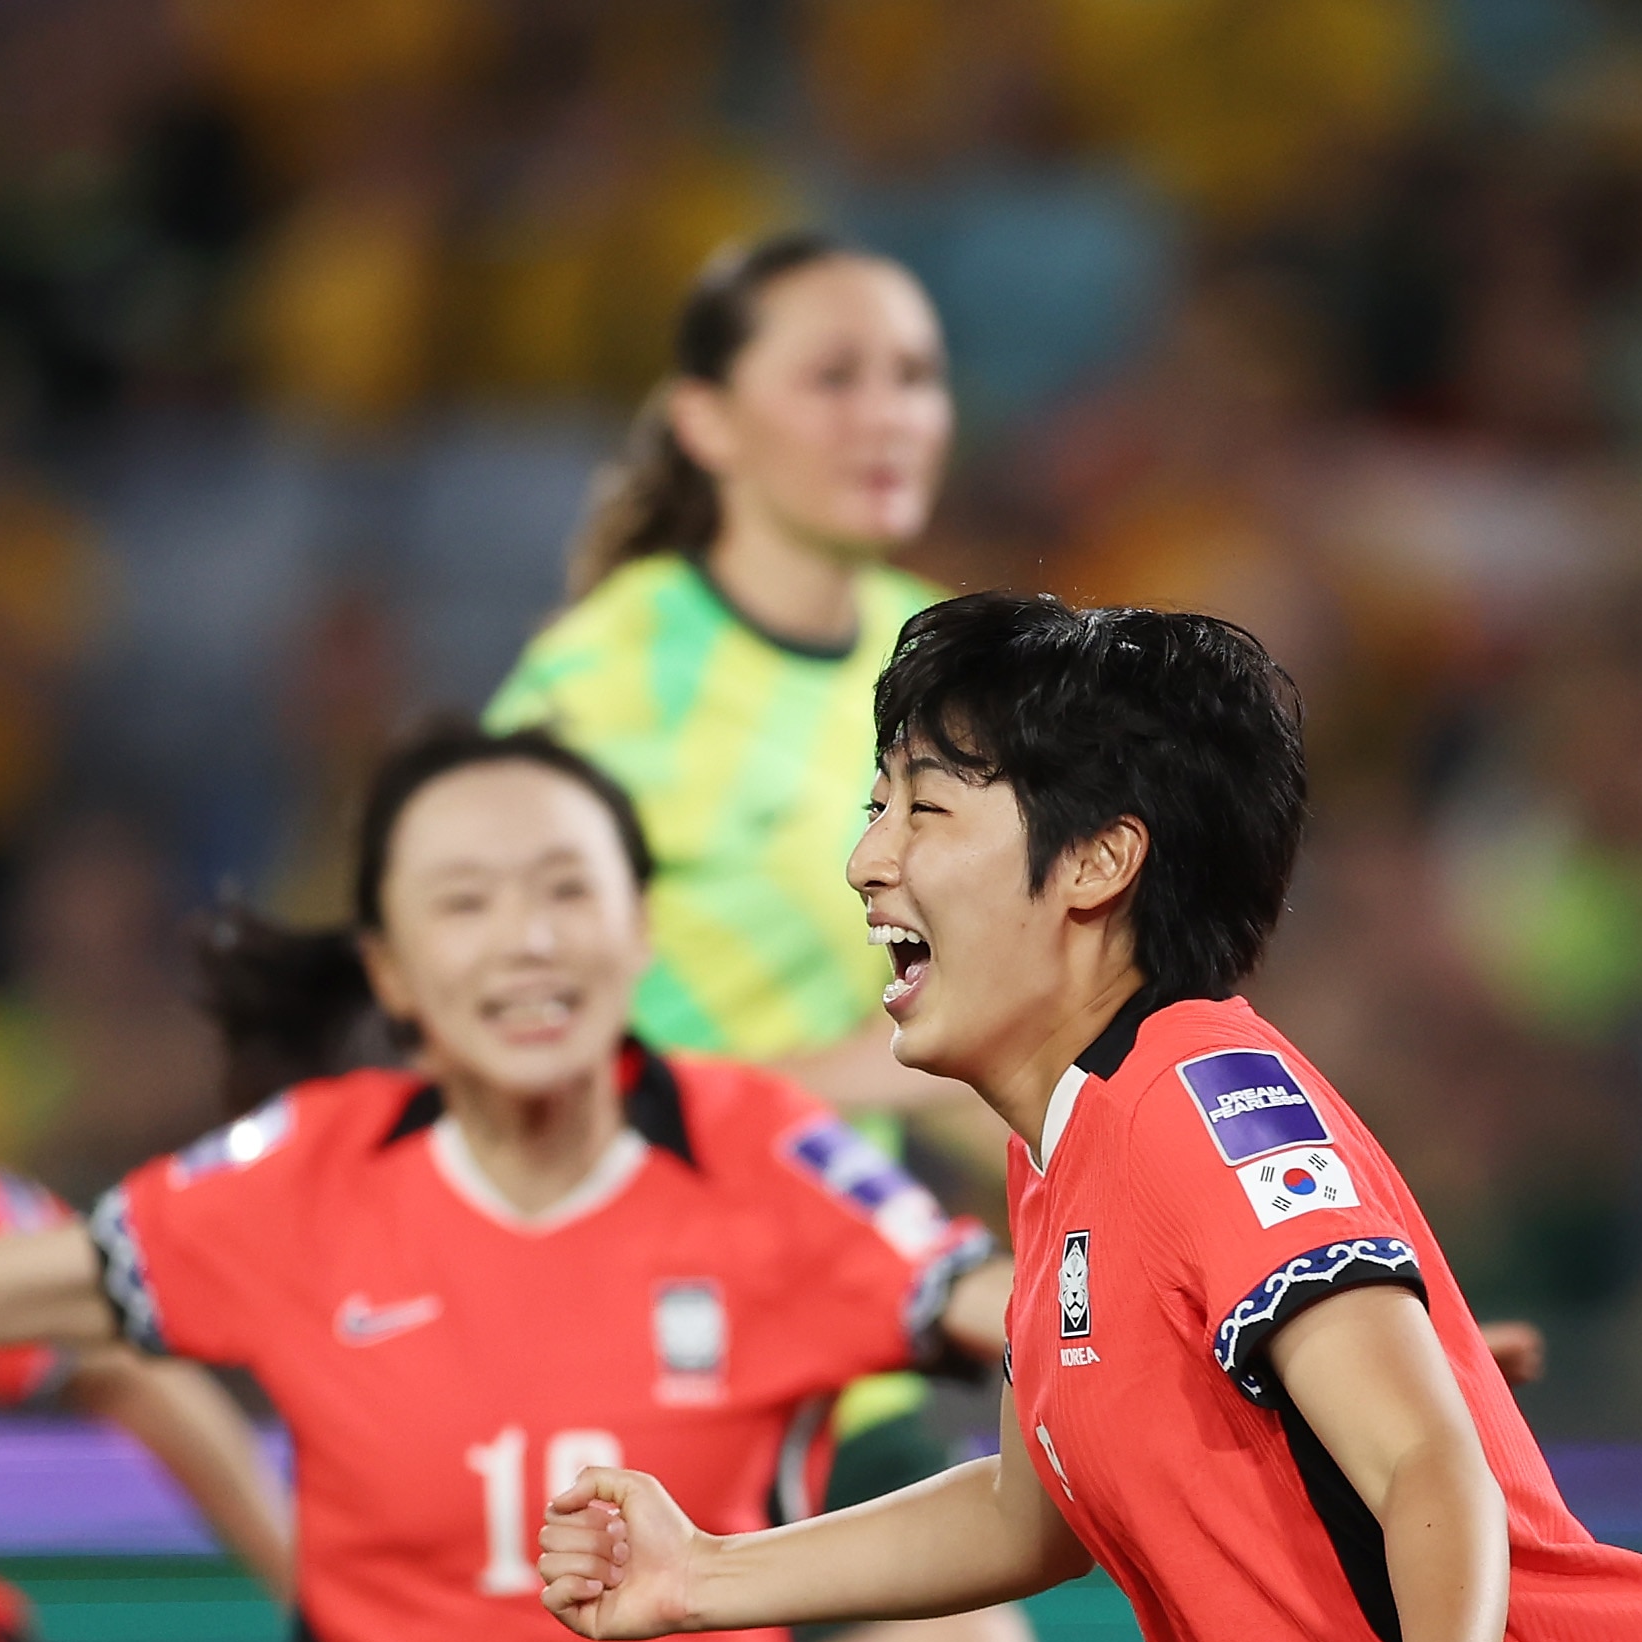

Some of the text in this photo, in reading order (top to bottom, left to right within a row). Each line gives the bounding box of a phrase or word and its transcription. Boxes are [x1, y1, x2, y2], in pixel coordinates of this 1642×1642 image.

[1216, 1085, 1289, 1107] DREAM
[1209, 1094, 1306, 1124] FEARLESS
[1060, 1346, 1101, 1367] KOREA
